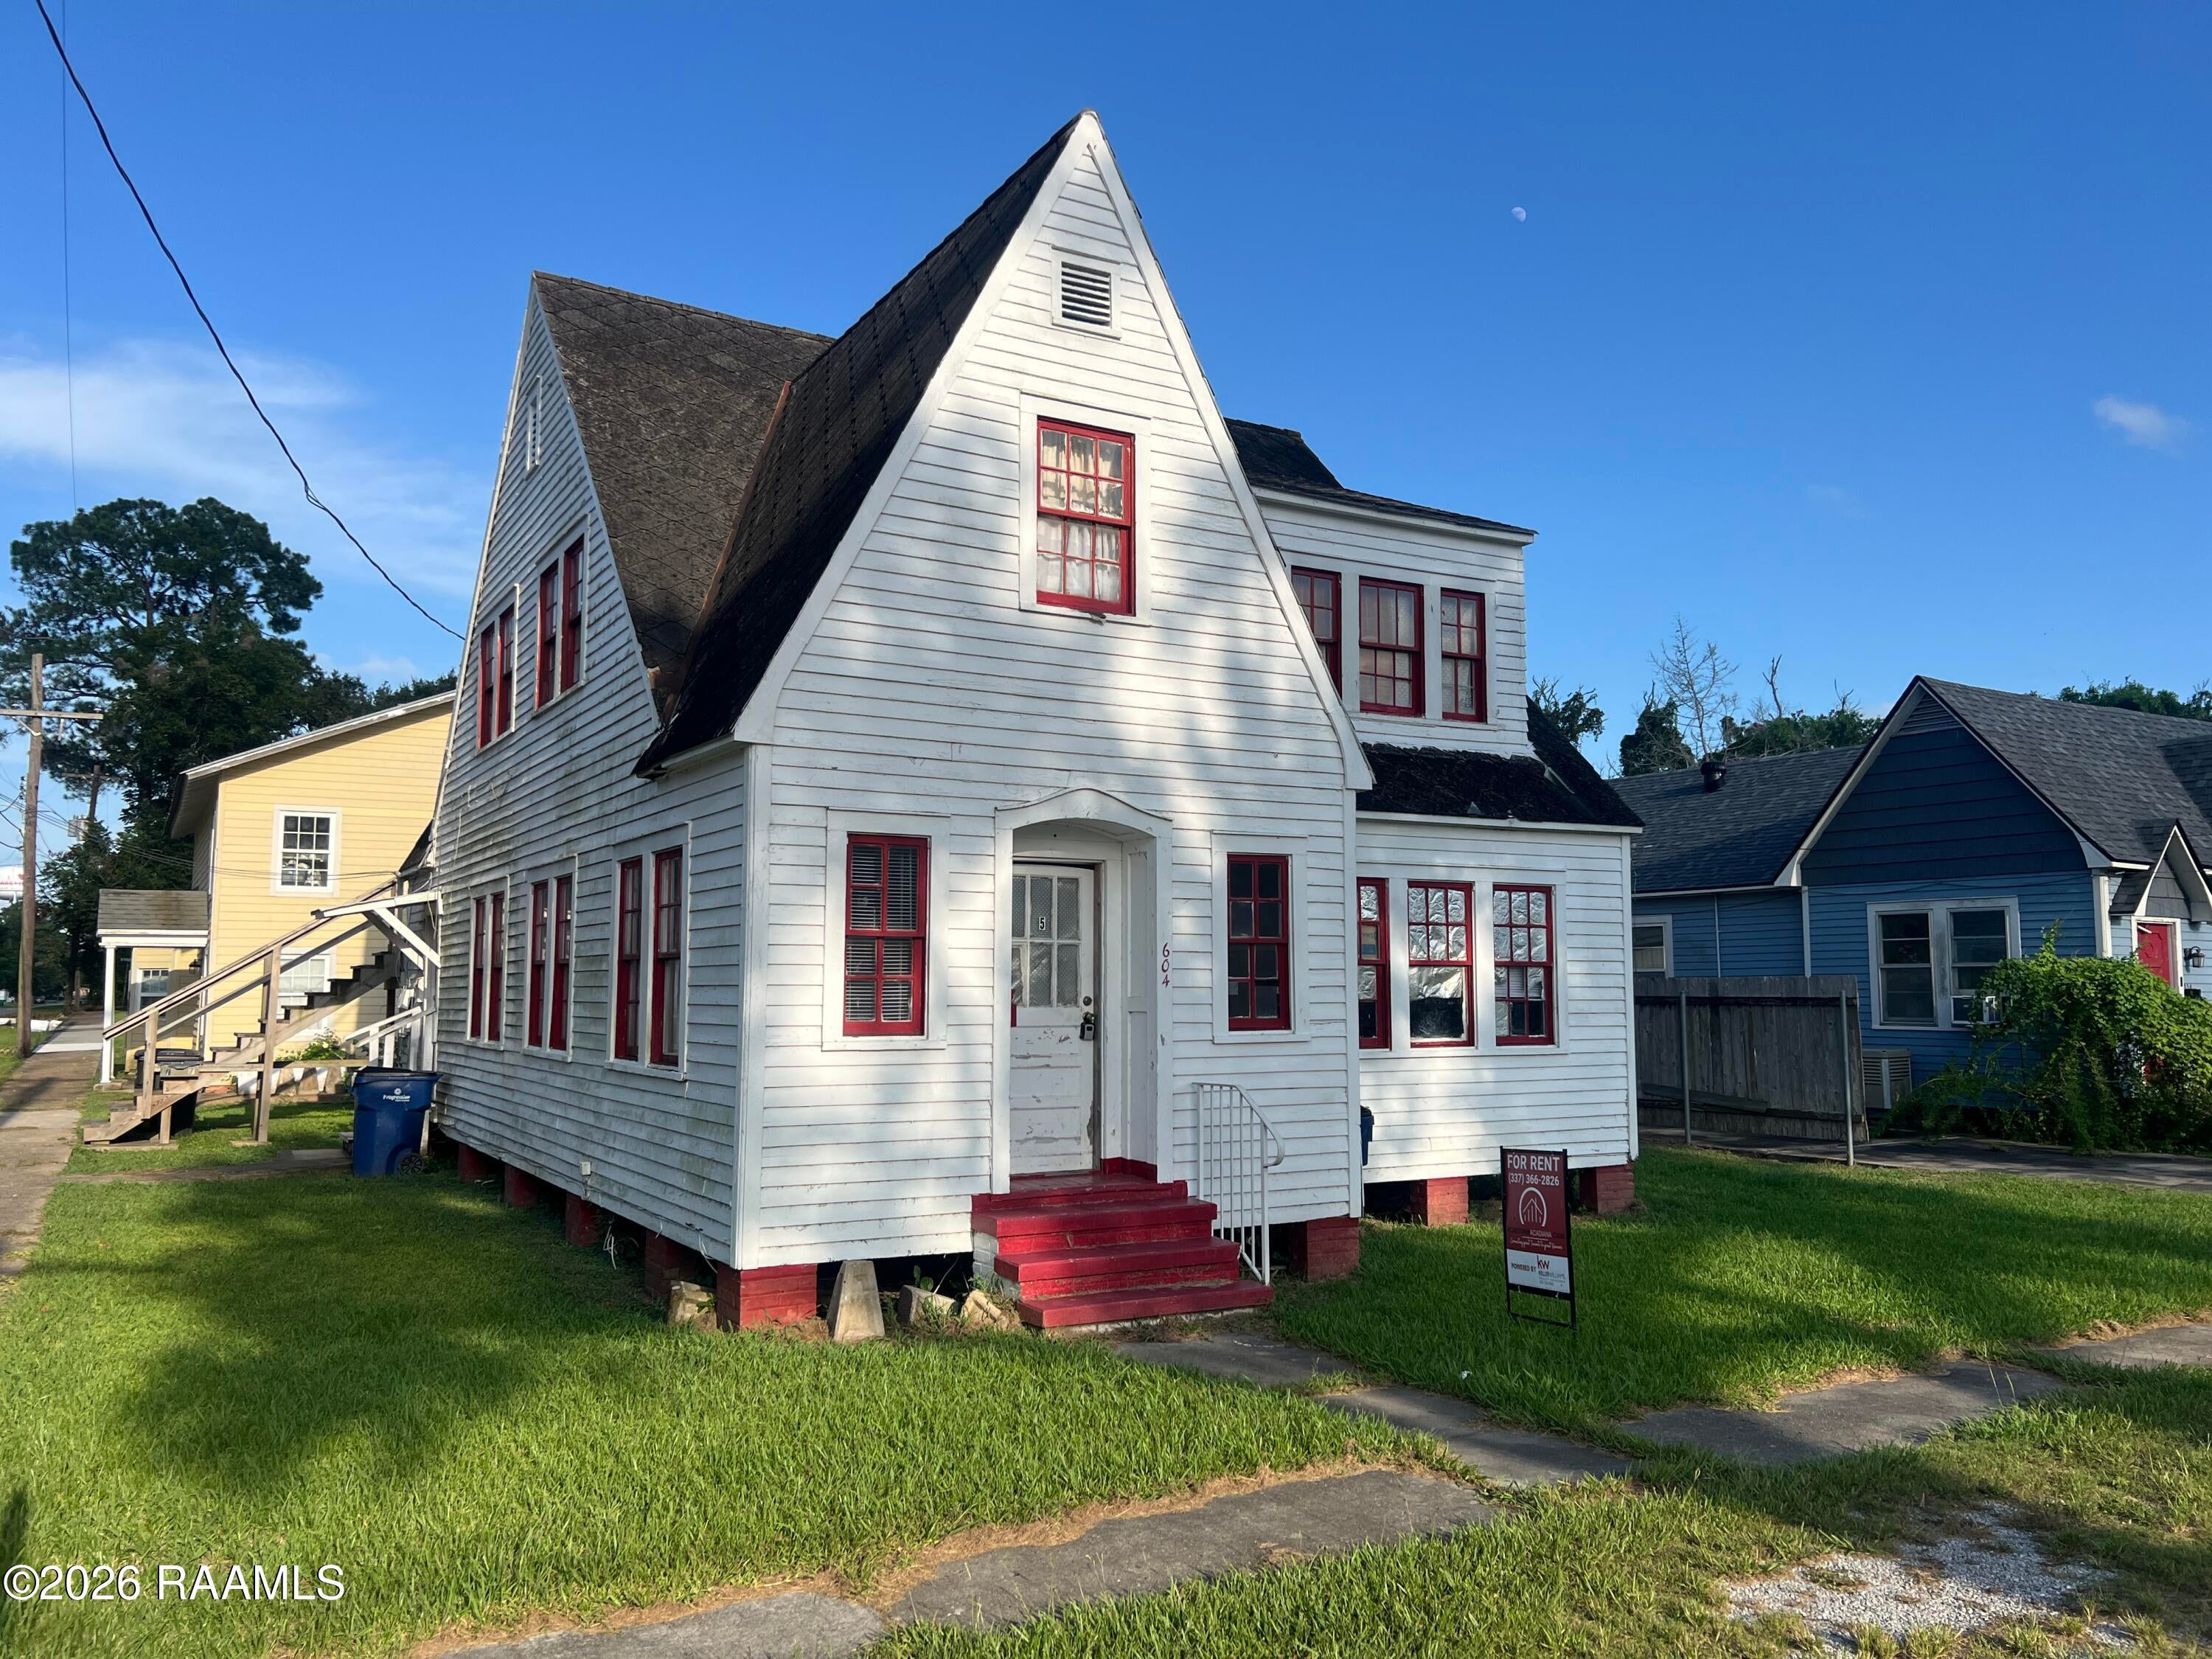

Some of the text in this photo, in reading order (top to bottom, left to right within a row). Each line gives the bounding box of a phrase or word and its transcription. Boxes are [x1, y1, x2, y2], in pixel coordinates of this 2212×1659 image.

[1161, 942, 1170, 988] 604
[1507, 1154, 1560, 1172] FOR RENT
[1508, 1172, 1559, 1186] (337) 366-2826
[1511, 1262, 1530, 1271] POWERED
